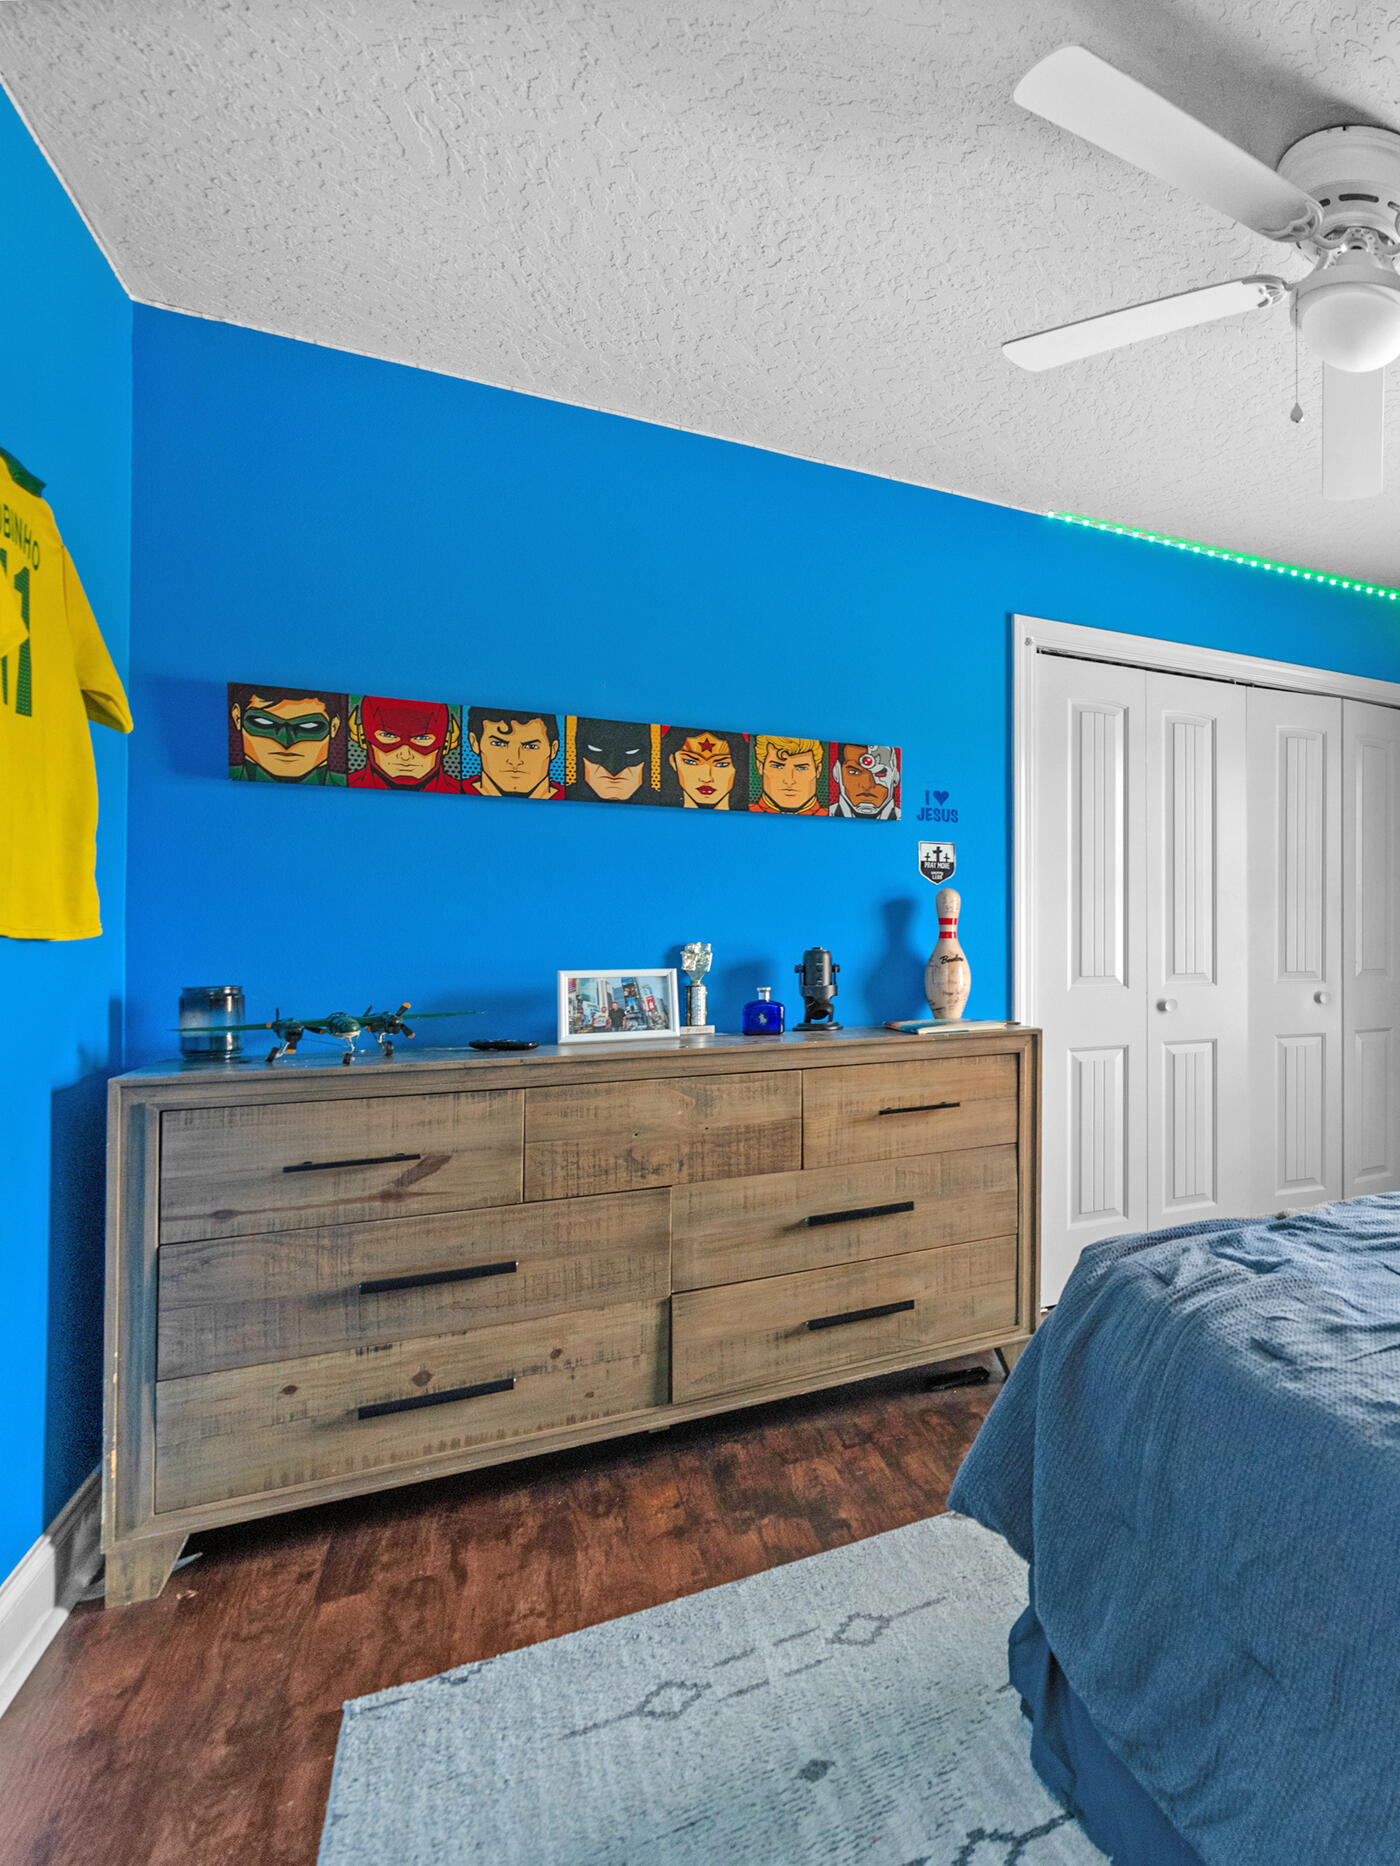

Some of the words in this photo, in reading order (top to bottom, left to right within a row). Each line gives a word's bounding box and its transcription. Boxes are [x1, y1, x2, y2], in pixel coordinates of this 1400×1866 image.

[0, 503, 41, 571] BINHO
[925, 789, 930, 806] I
[916, 807, 959, 823] JESUS
